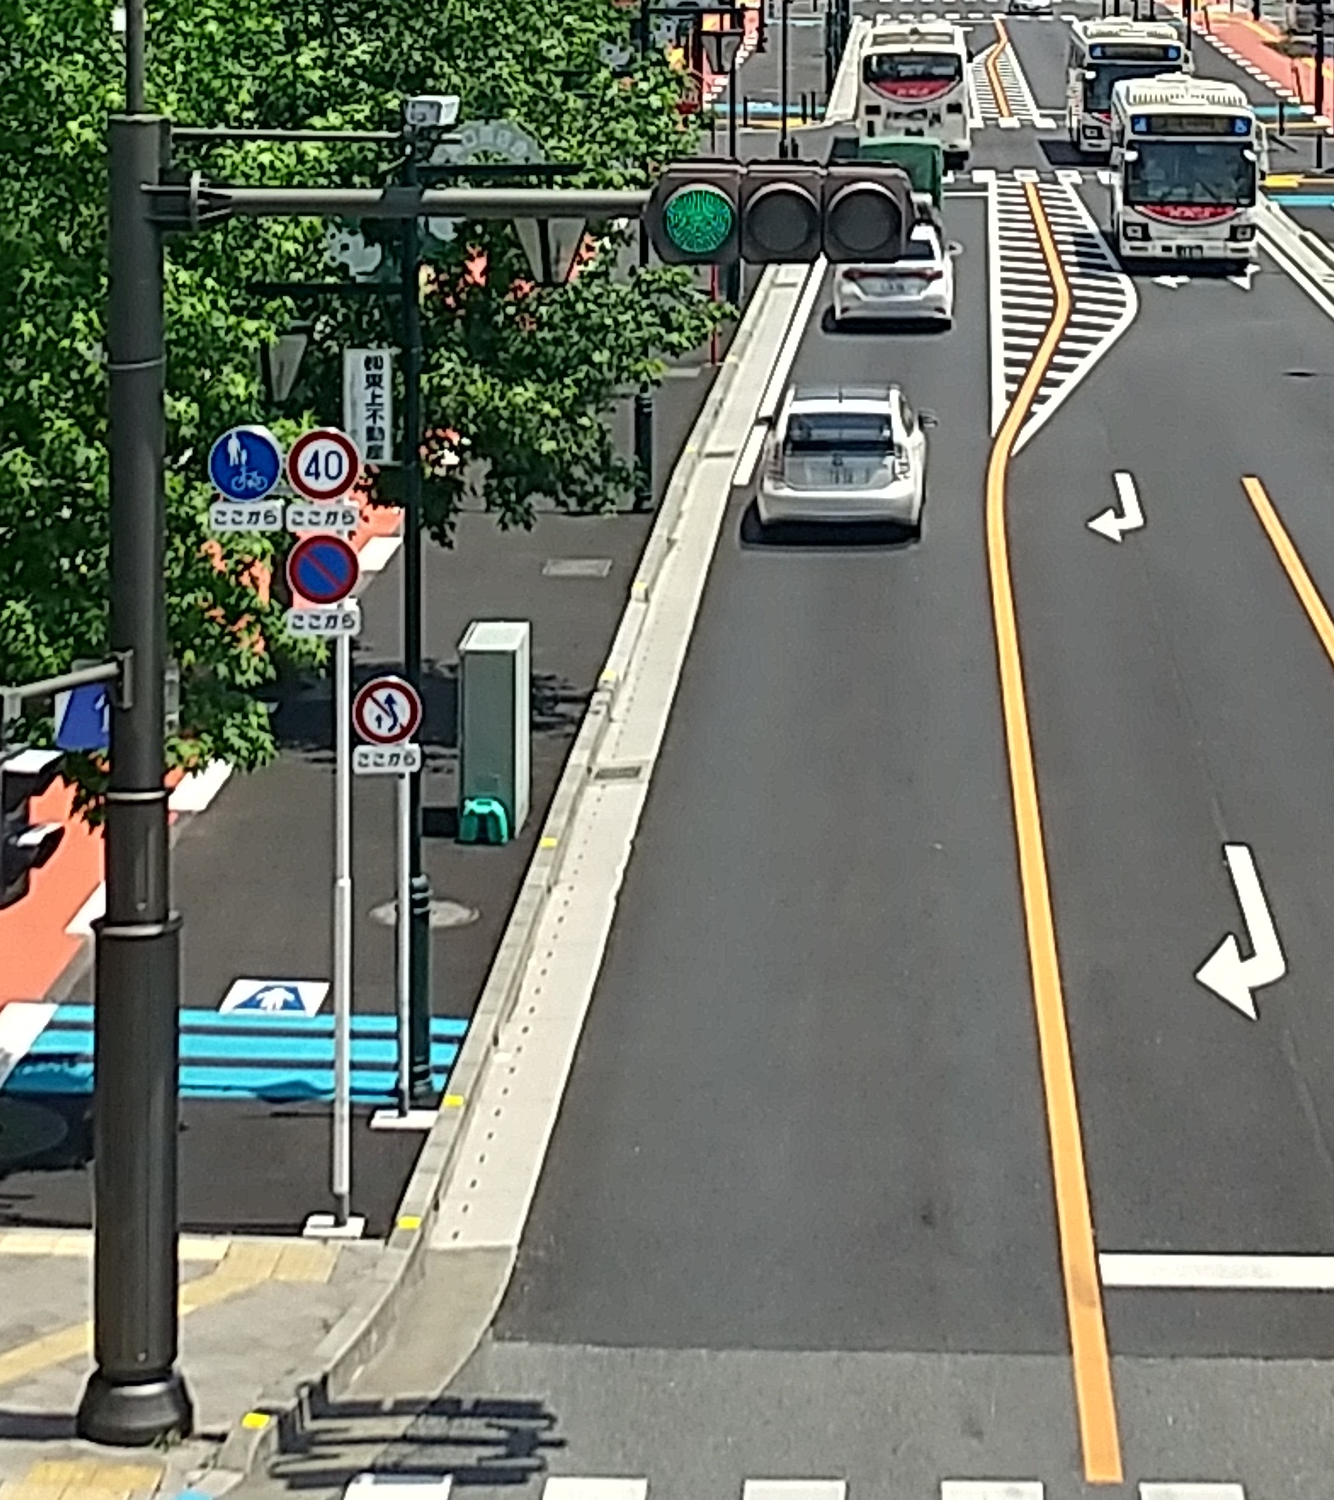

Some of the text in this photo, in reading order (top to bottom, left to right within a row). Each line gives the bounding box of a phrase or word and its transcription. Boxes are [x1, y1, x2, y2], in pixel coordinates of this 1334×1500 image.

[304, 450, 343, 481] 40
[213, 510, 278, 526] ここから
[290, 510, 356, 526] ここから
[290, 614, 356, 631] ここから
[357, 752, 417, 768] ここから
